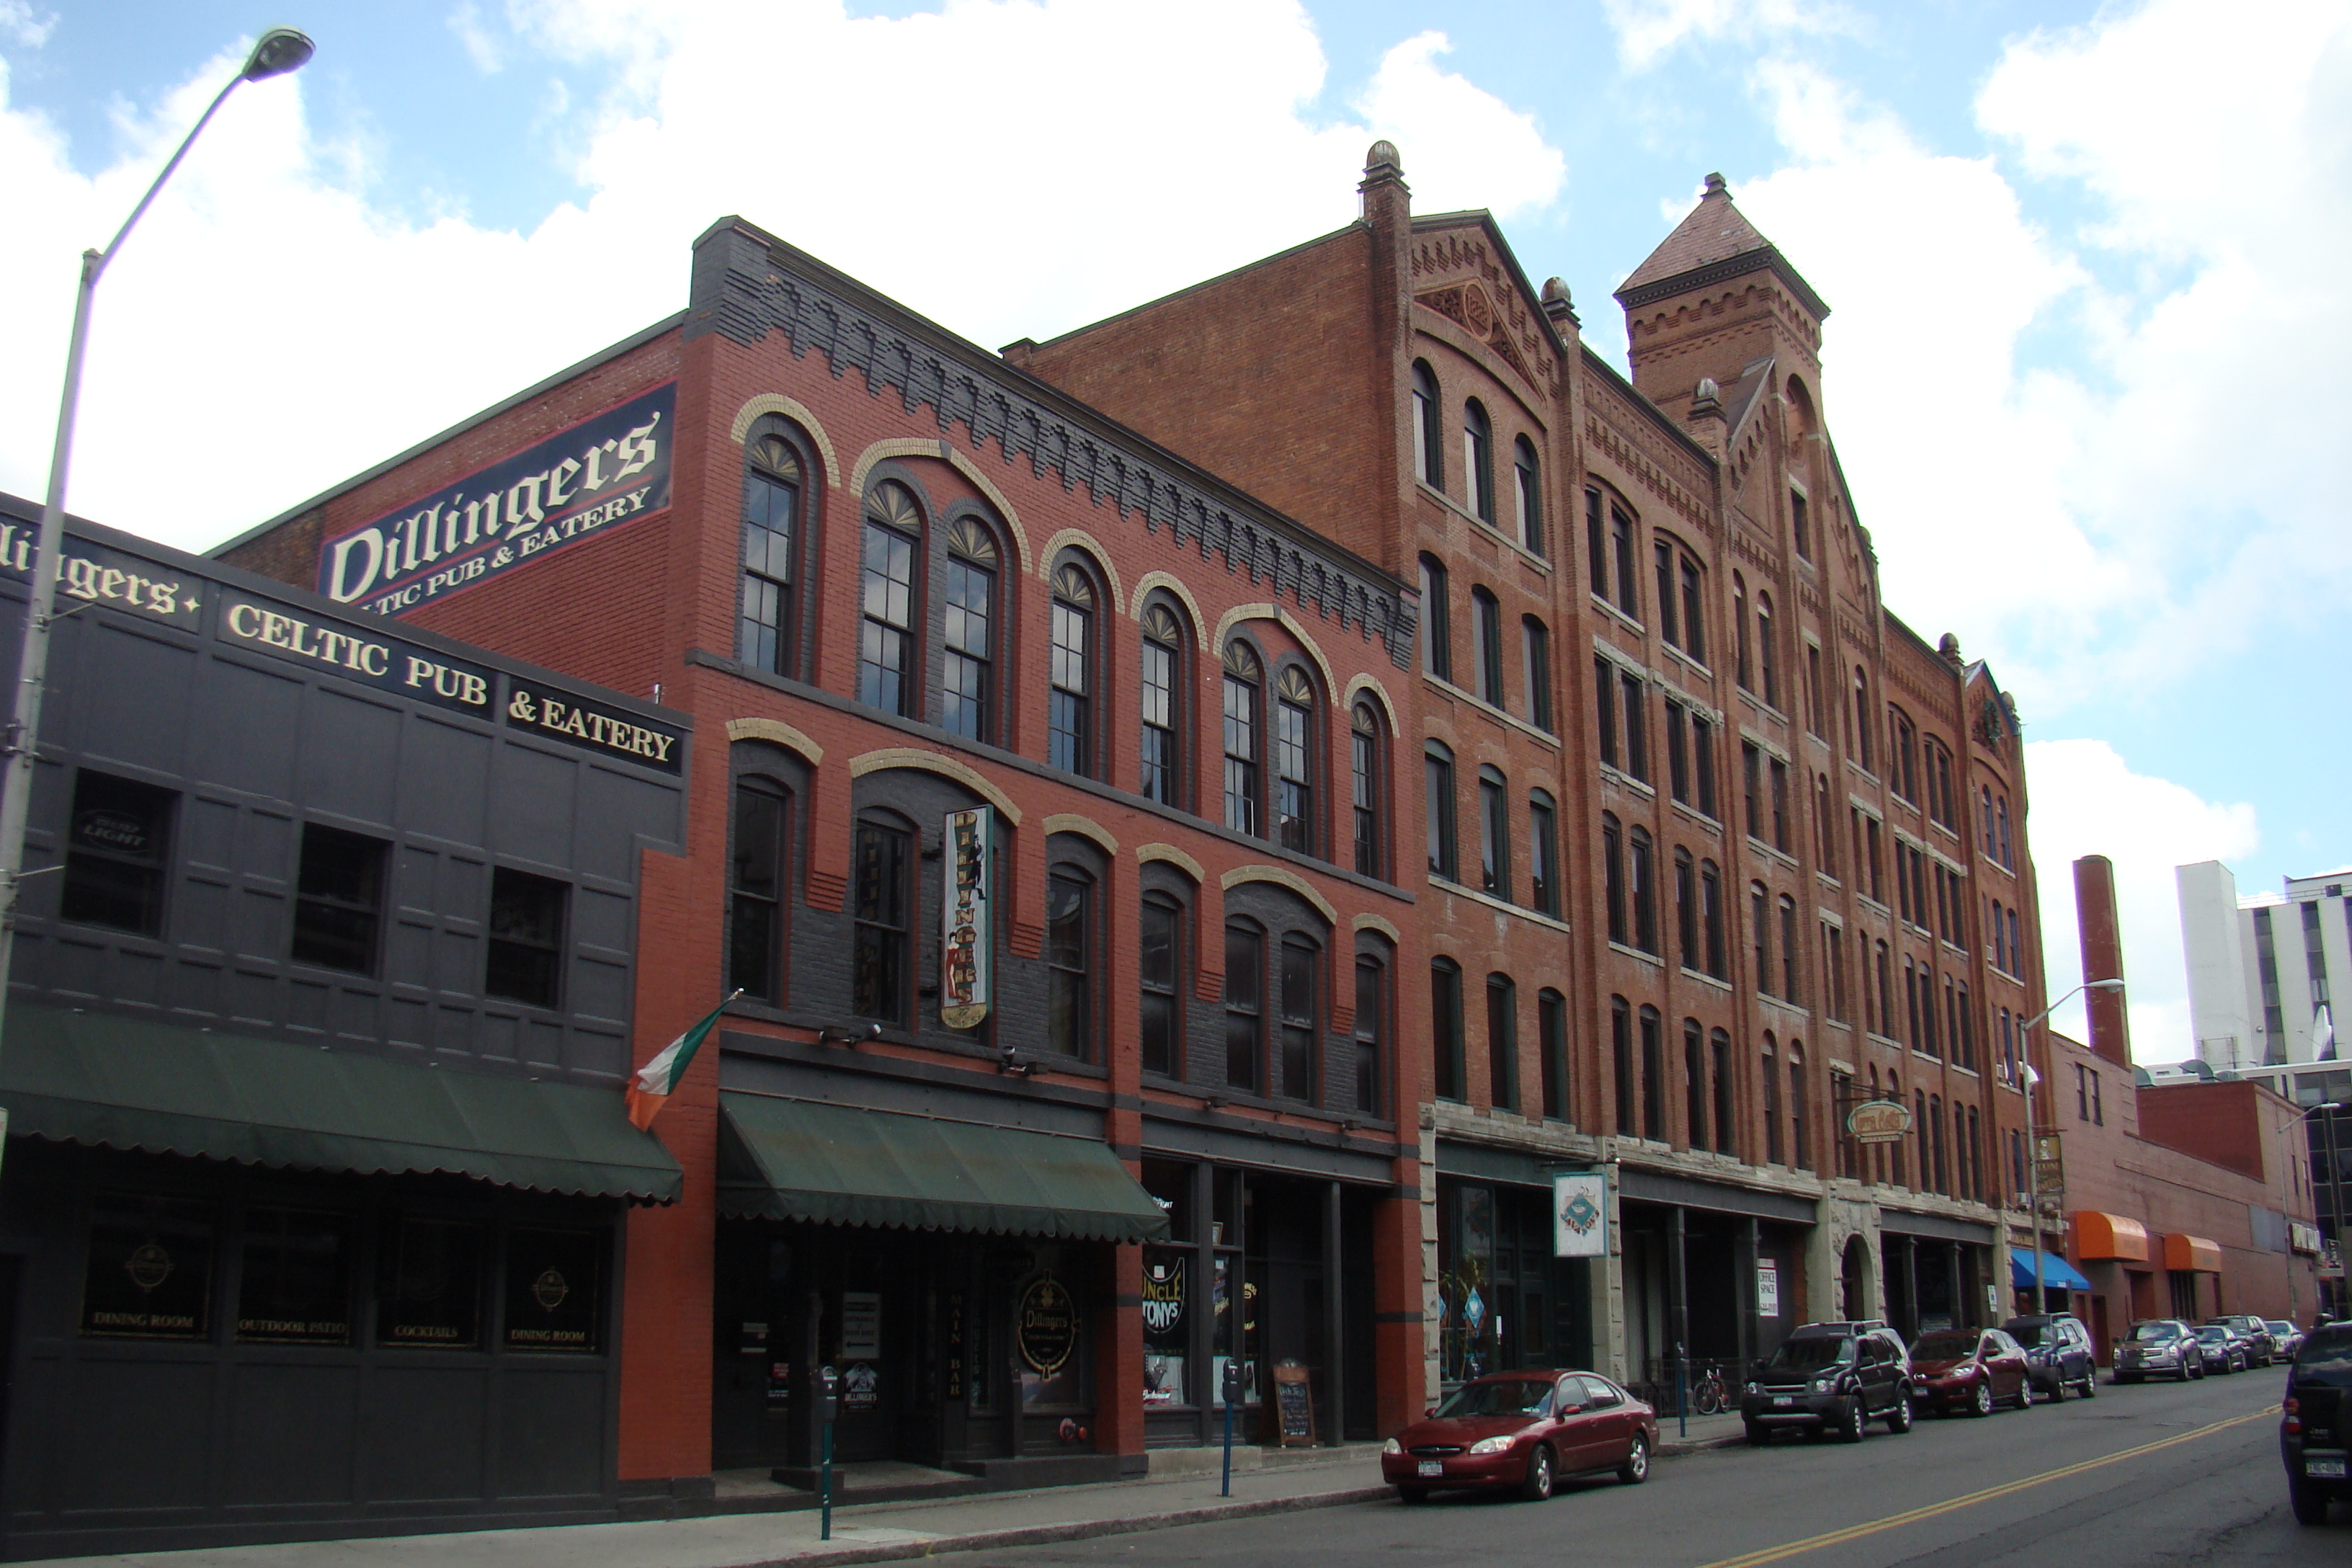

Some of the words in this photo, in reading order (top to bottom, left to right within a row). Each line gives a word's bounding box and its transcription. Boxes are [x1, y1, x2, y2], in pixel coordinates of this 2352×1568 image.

[361, 584, 422, 615] TIC
[427, 557, 486, 597] PUB
[491, 546, 514, 568] &
[519, 486, 651, 557] EATERY
[228, 604, 389, 676] CELTIC
[405, 656, 487, 705] PUB
[509, 691, 536, 722] &
[540, 698, 674, 762] EATERY
[83, 824, 147, 847] LIGHT
[1759, 1272, 1775, 1283] OFFICE
[1760, 1284, 1775, 1293] SPACE
[92, 1312, 147, 1327] DINING
[150, 1314, 195, 1329] ROOM
[239, 1319, 306, 1333] OUTDOOR
[308, 1320, 347, 1334] PATIO
[950, 1295, 963, 1344] MAIN
[396, 1326, 459, 1339] COCKTAILS
[510, 1329, 551, 1341] DINING
[553, 1330, 585, 1342] ROOM
[950, 1358, 961, 1395] BAR
